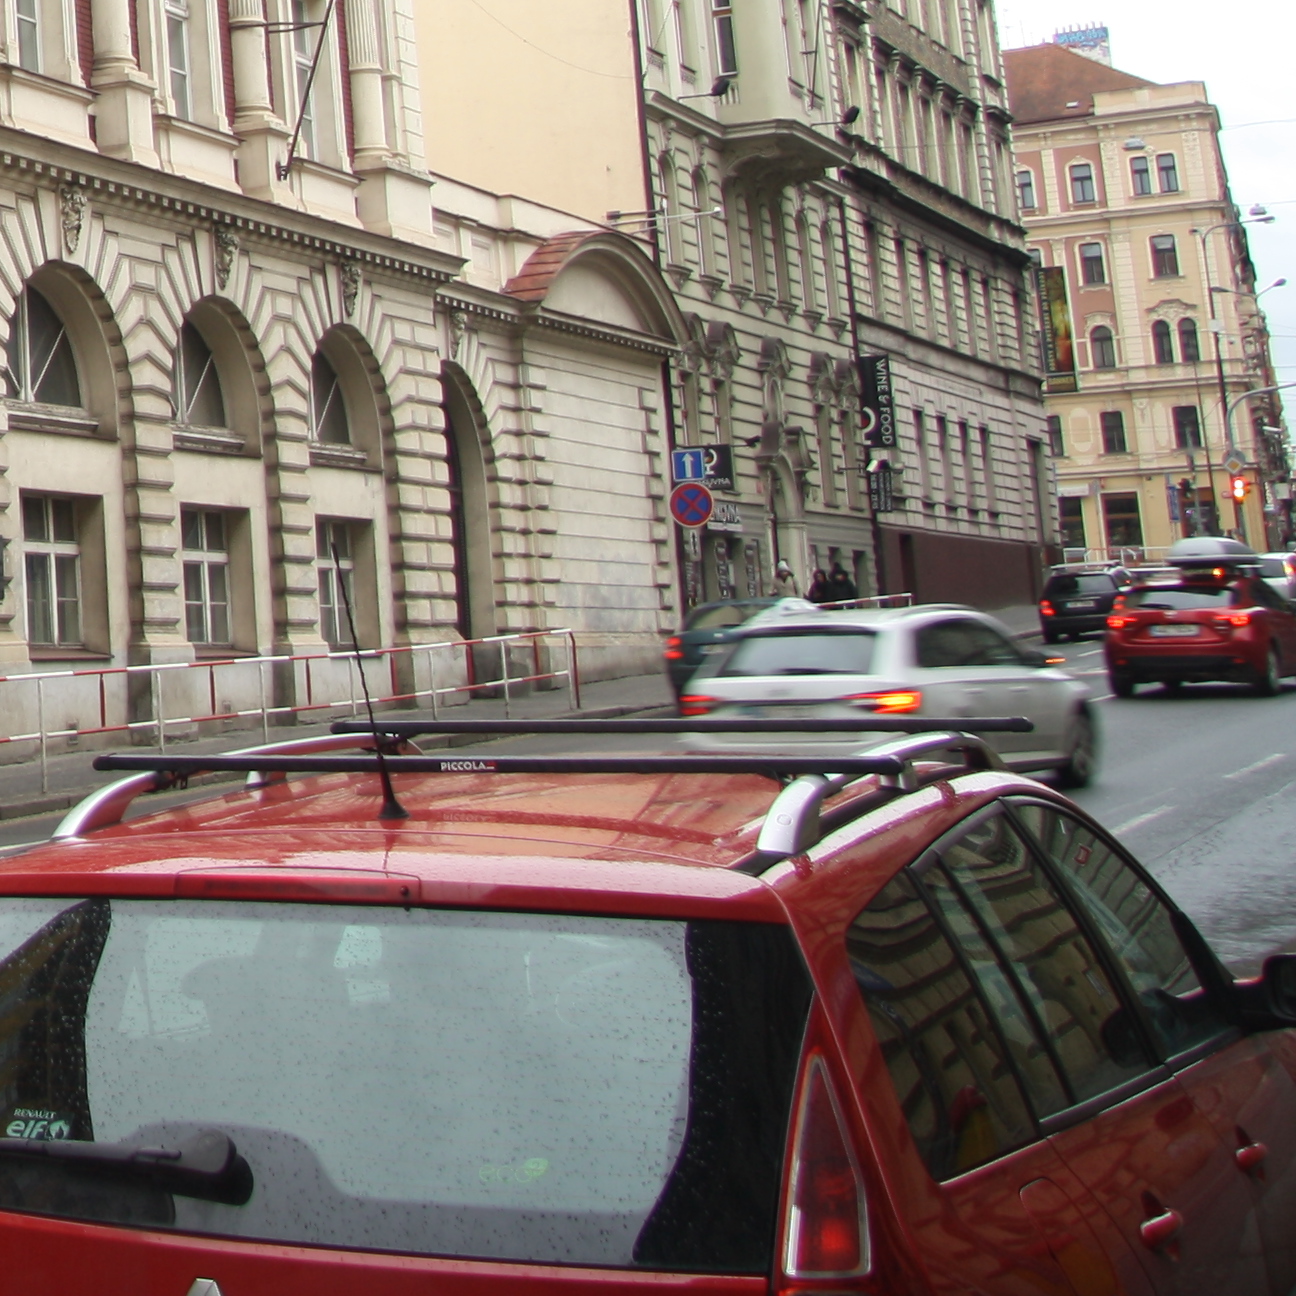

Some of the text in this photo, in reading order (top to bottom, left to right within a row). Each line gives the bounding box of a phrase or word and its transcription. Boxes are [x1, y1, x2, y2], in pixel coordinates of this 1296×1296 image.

[876, 359, 889, 392] WINE
[880, 407, 893, 445] FOOD
[440, 761, 486, 772] PICCOLA
[13, 1108, 57, 1119] RENAULT
[6, 1120, 49, 1139] elf
